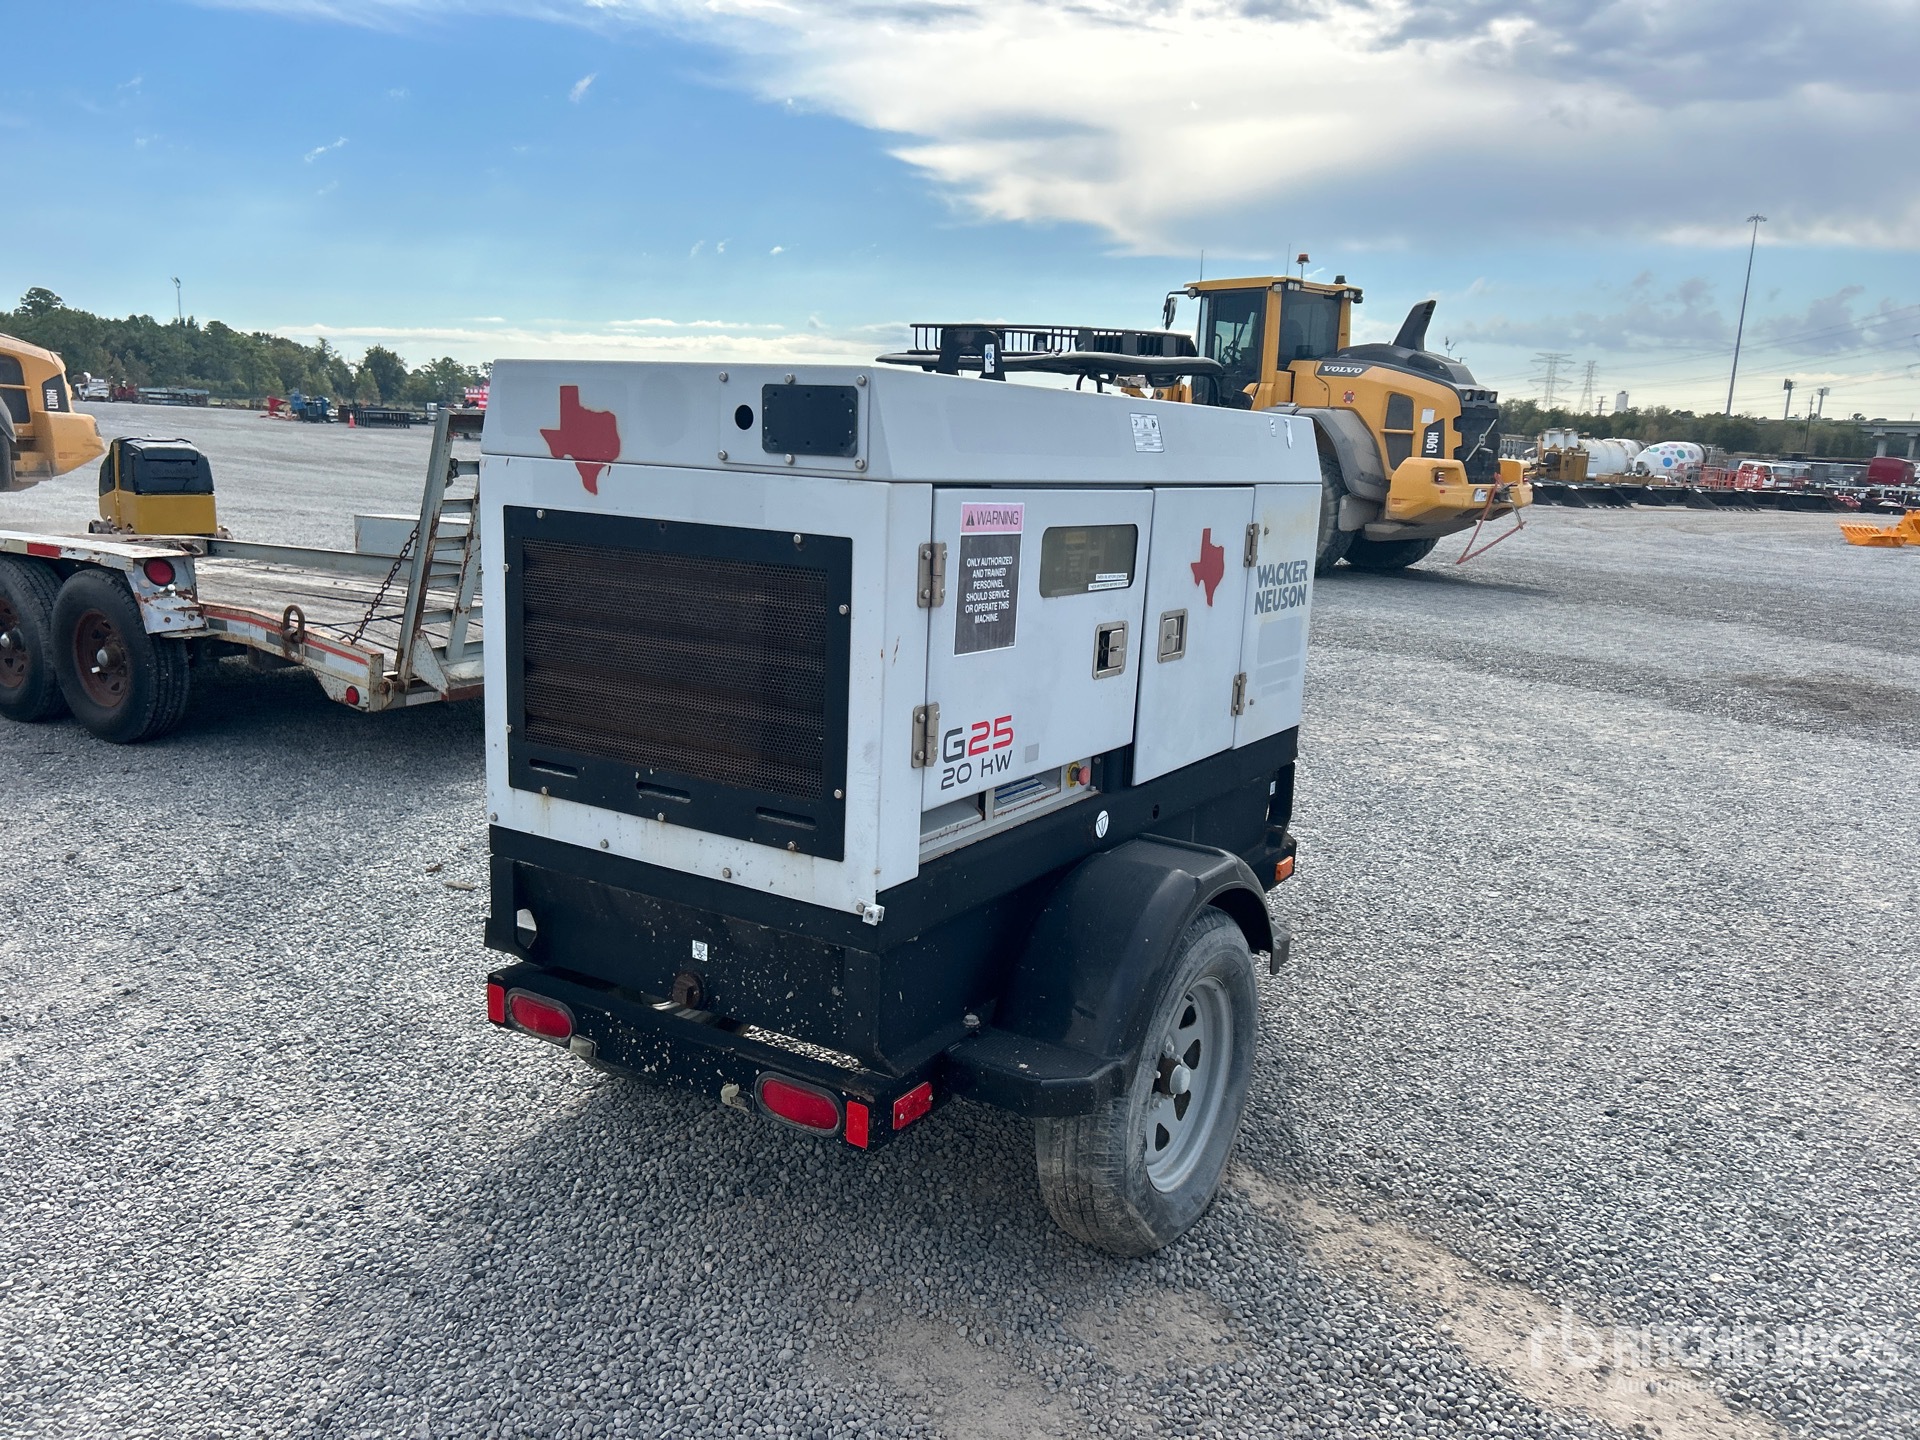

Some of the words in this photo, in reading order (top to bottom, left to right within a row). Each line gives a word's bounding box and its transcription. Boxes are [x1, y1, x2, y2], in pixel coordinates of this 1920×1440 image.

[1323, 365, 1363, 374] VOLVO
[1426, 432, 1439, 454] L90H
[976, 511, 1019, 526] WARNING
[966, 558, 981, 567] ONLY
[980, 556, 1013, 566] AUTHORIZED
[972, 569, 984, 578] AND
[984, 568, 1007, 577] TRAINED
[1257, 560, 1308, 588] WACKER
[973, 579, 1004, 590] PERSONNEL
[966, 591, 988, 602] SHOULD
[988, 590, 1010, 600] SERVICE
[1254, 584, 1307, 615] NEUSON
[965, 604, 974, 613] OR
[974, 602, 998, 613] OPERATE
[998, 601, 1009, 610] THIS
[975, 613, 999, 624] MACHINE.
[942, 715, 1014, 763] G25
[941, 762, 972, 790] 20
